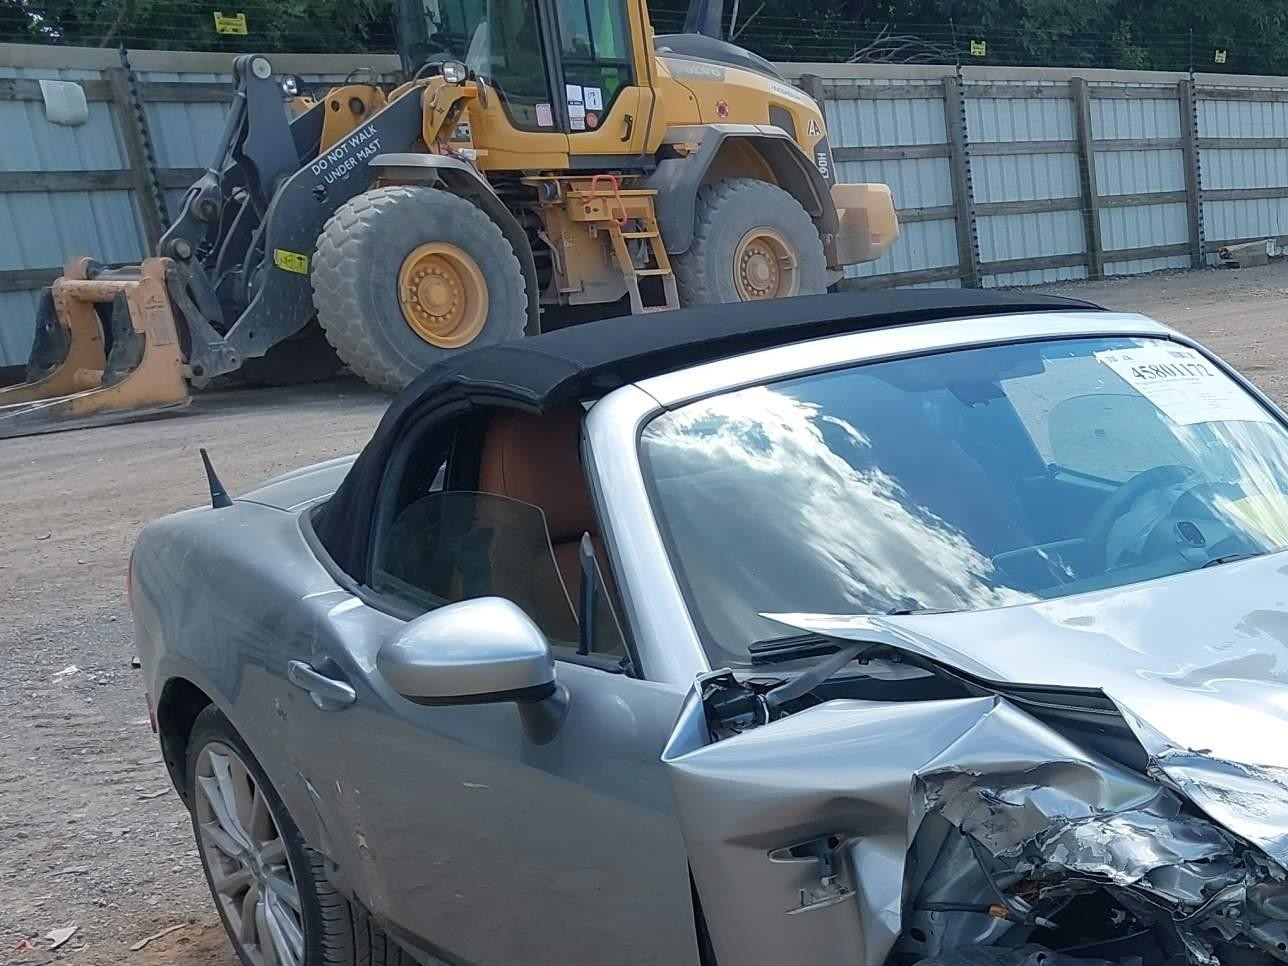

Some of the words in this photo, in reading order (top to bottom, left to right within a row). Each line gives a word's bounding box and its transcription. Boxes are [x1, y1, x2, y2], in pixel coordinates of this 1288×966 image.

[311, 159, 328, 175] DO
[327, 143, 349, 163] NOT
[348, 124, 378, 148] WALK
[324, 157, 358, 184] UNDER
[356, 138, 382, 161] MAST
[1131, 363, 1214, 380] 45801172
